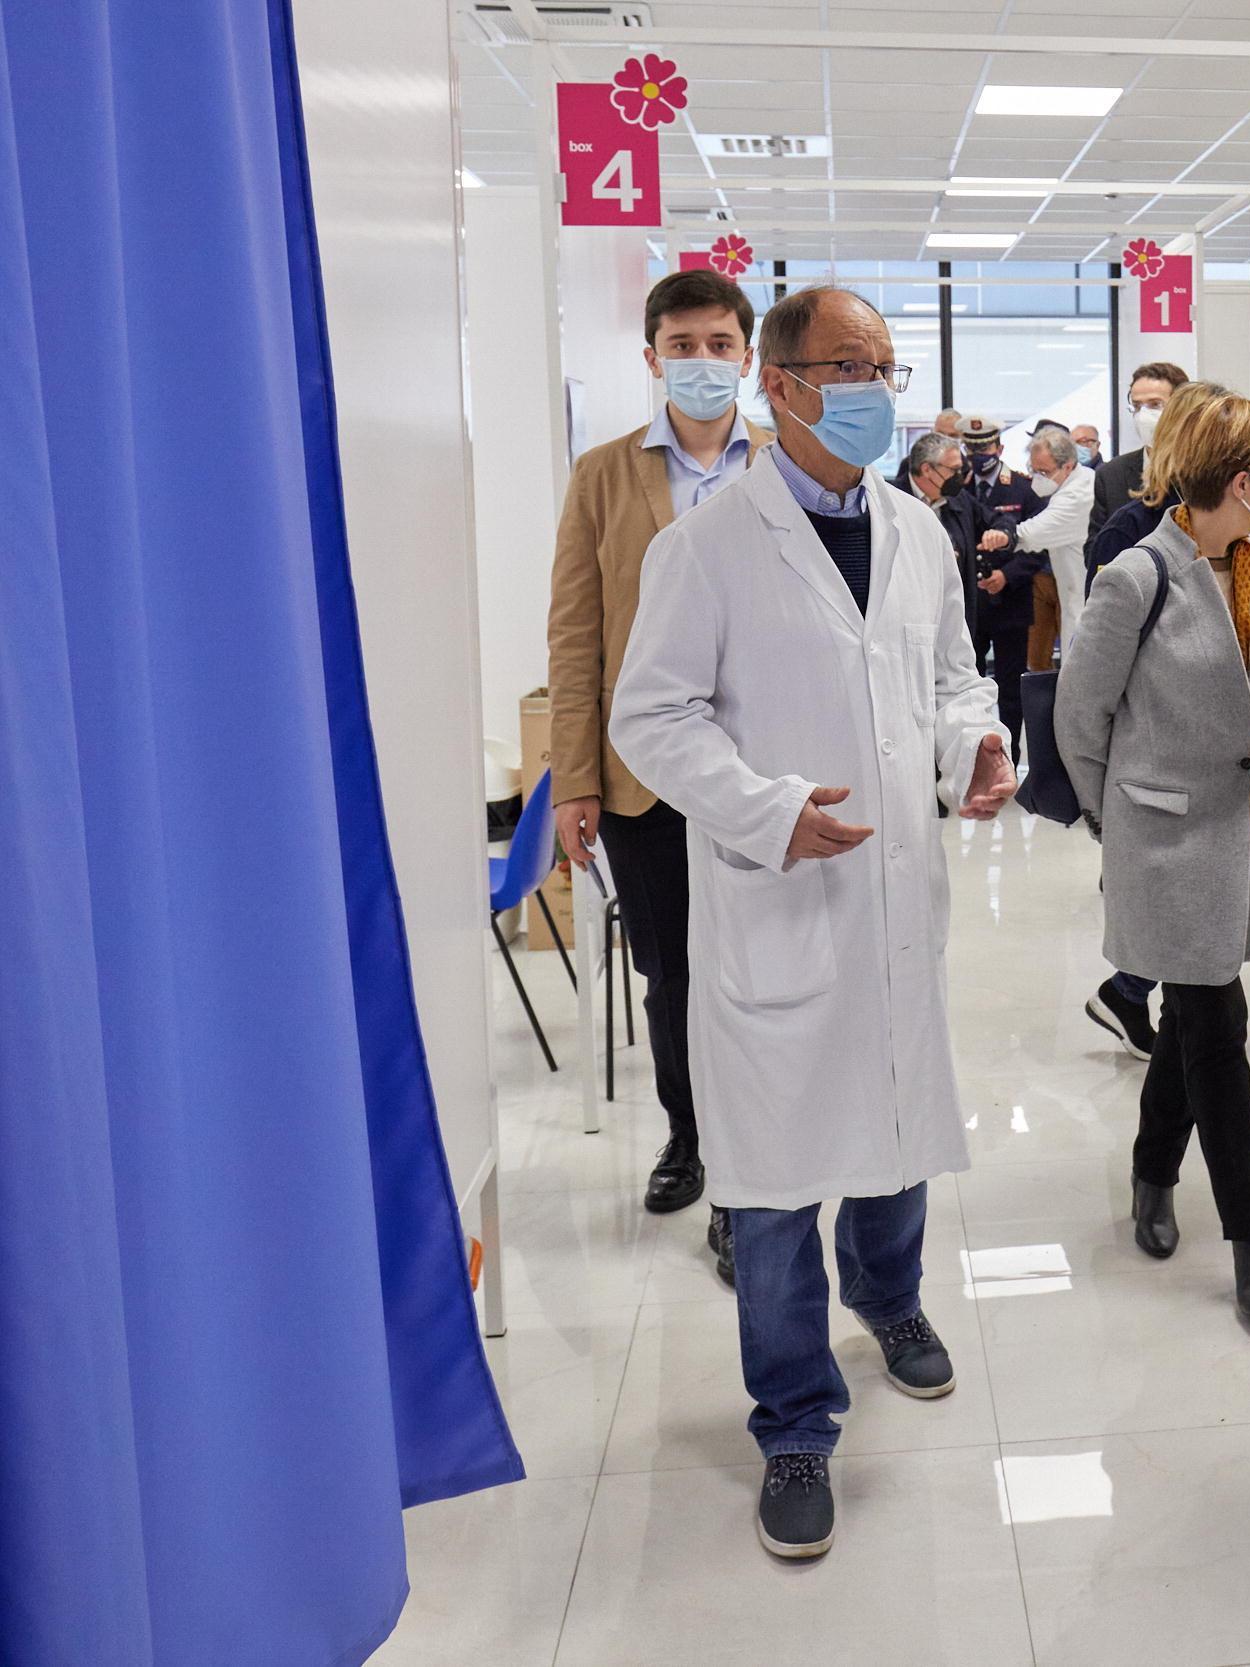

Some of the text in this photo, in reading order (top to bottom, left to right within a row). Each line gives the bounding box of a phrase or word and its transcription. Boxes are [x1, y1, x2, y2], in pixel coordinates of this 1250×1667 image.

[569, 140, 593, 152] box
[592, 150, 643, 212] 4
[1173, 286, 1187, 294] box
[1153, 291, 1170, 326] 1
